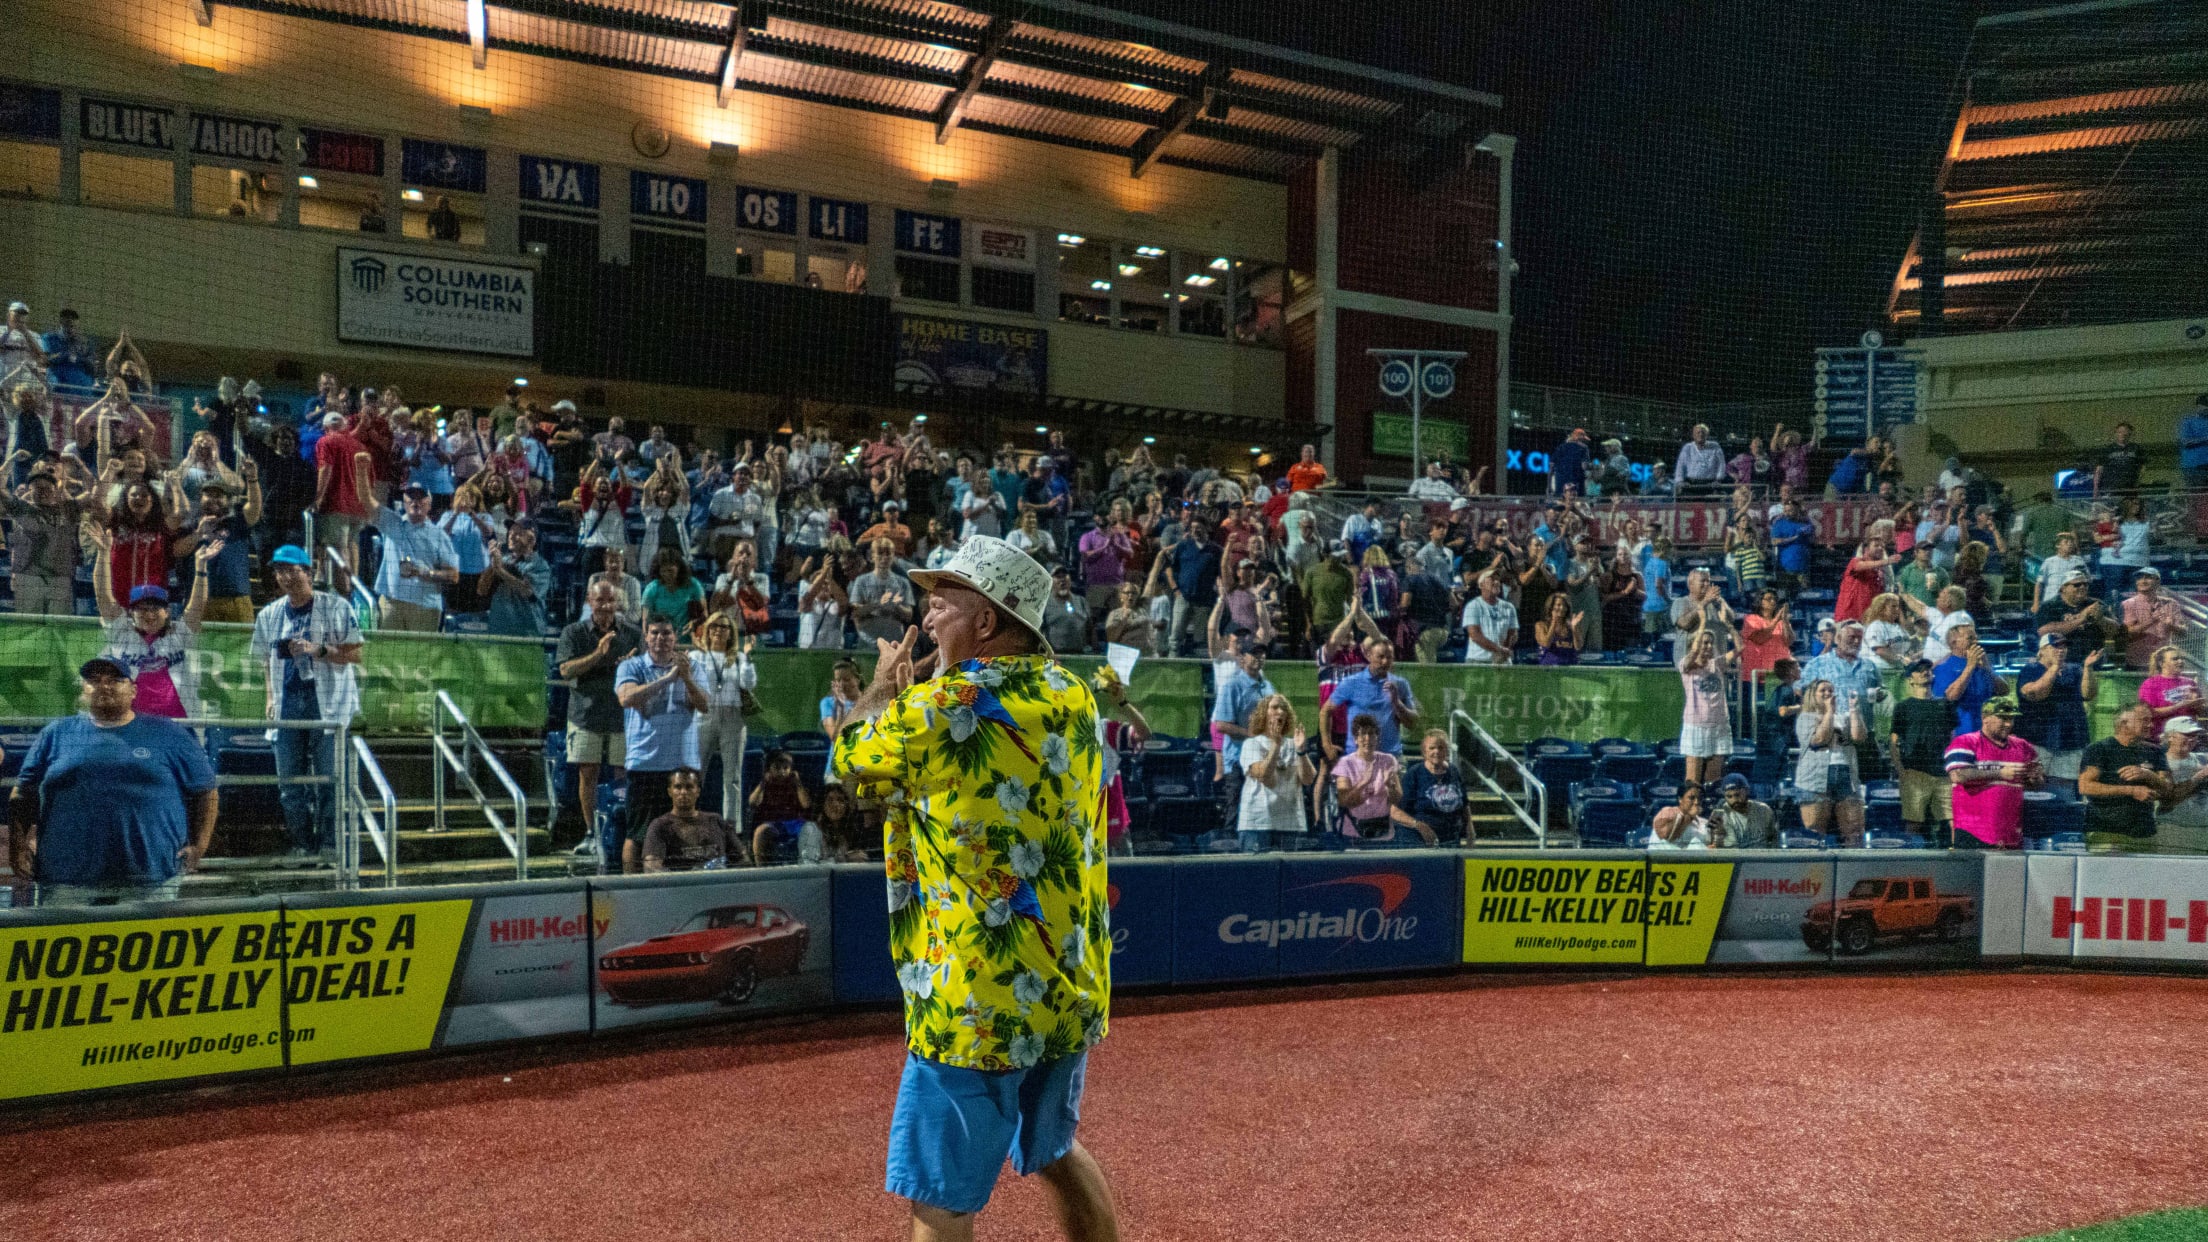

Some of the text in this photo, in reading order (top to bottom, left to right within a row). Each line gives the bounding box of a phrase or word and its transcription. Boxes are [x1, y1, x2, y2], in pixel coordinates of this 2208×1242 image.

[537, 163, 945, 251] WA HO OS LI FE
[397, 264, 527, 294] COLUMBIA
[403, 285, 522, 314] SOUTHERN
[414, 308, 510, 323] UNIVERSITY
[902, 318, 1039, 349] HOME BASE
[1384, 372, 1406, 385] 100
[1428, 373, 1450, 386] 101
[1442, 687, 1605, 718] REGIONS
[1494, 723, 1605, 741] SEATS
[1481, 867, 1700, 897] NOBODY BEATS A
[1744, 879, 1822, 896] Hill-Kelly
[1478, 897, 1697, 926] HILL-KELLY DEAL!
[489, 914, 610, 943] Hill-Kelly
[5, 913, 417, 983] NOBODY BEATS A
[1514, 936, 1637, 951] HillKellyDodge.com
[2, 957, 411, 1033] HILL-KELLY DEAL!
[81, 1025, 316, 1067] HillKellyDodge.com
